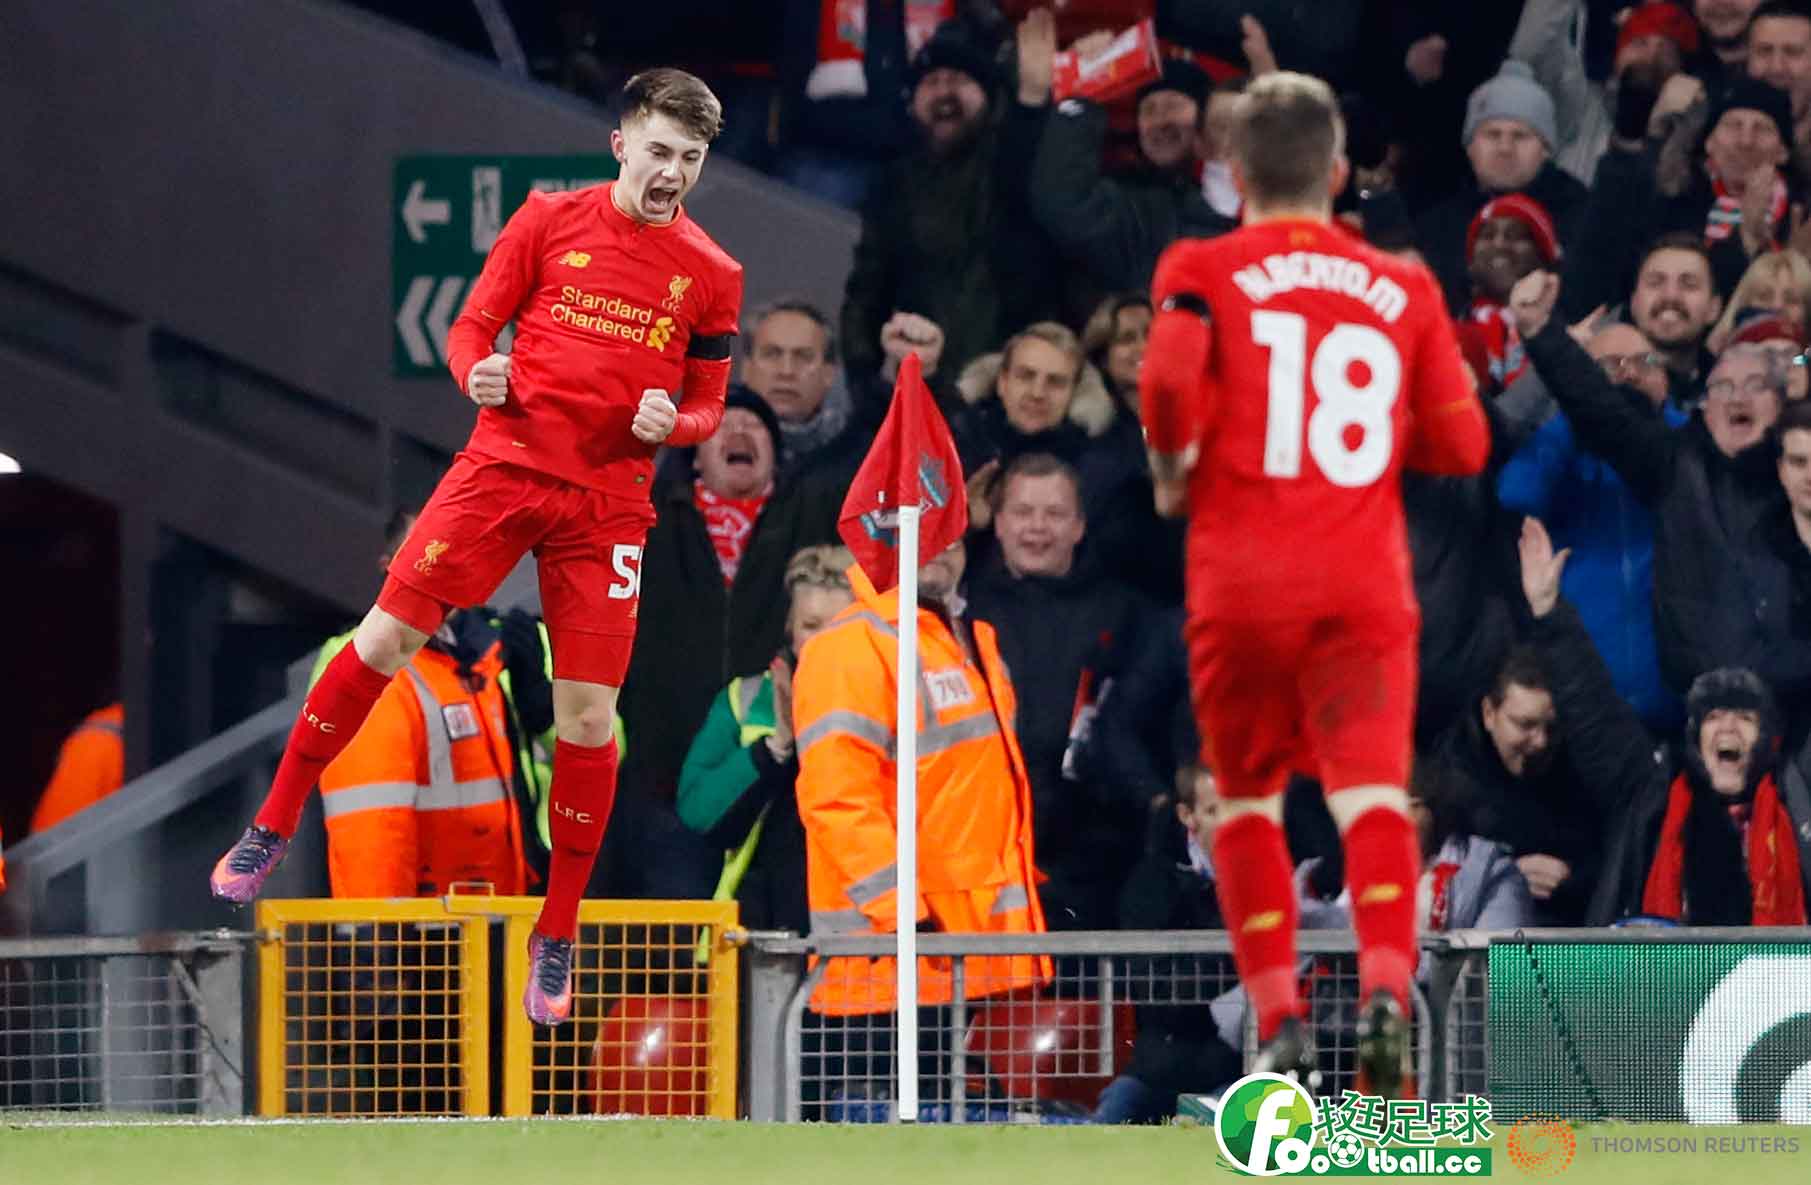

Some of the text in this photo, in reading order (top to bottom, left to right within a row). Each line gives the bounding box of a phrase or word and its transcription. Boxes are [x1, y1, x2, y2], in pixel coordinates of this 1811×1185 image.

[550, 303, 645, 344] Chartered
[560, 285, 653, 325] Standard
[1250, 309, 1402, 488] 18
